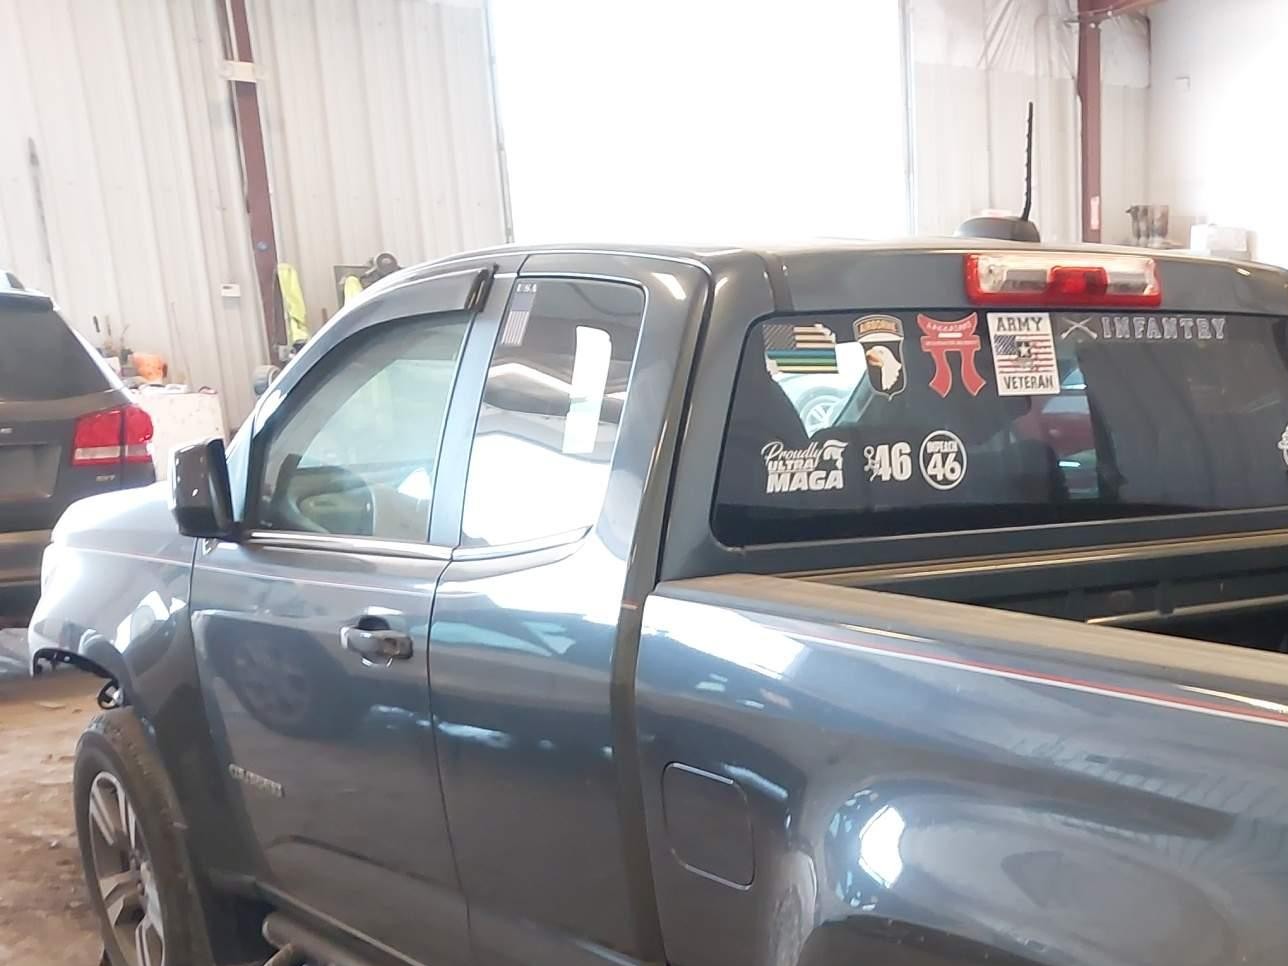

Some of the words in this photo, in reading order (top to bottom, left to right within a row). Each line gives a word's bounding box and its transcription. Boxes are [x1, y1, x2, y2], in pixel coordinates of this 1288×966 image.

[996, 317, 1043, 332] ARMY
[1101, 316, 1226, 339] INFANTRY
[1004, 374, 1054, 390] VETERAN
[761, 441, 824, 465] Proudly
[767, 458, 816, 472] ULTRA
[927, 452, 961, 481] 46
[766, 469, 844, 494] MAGA
